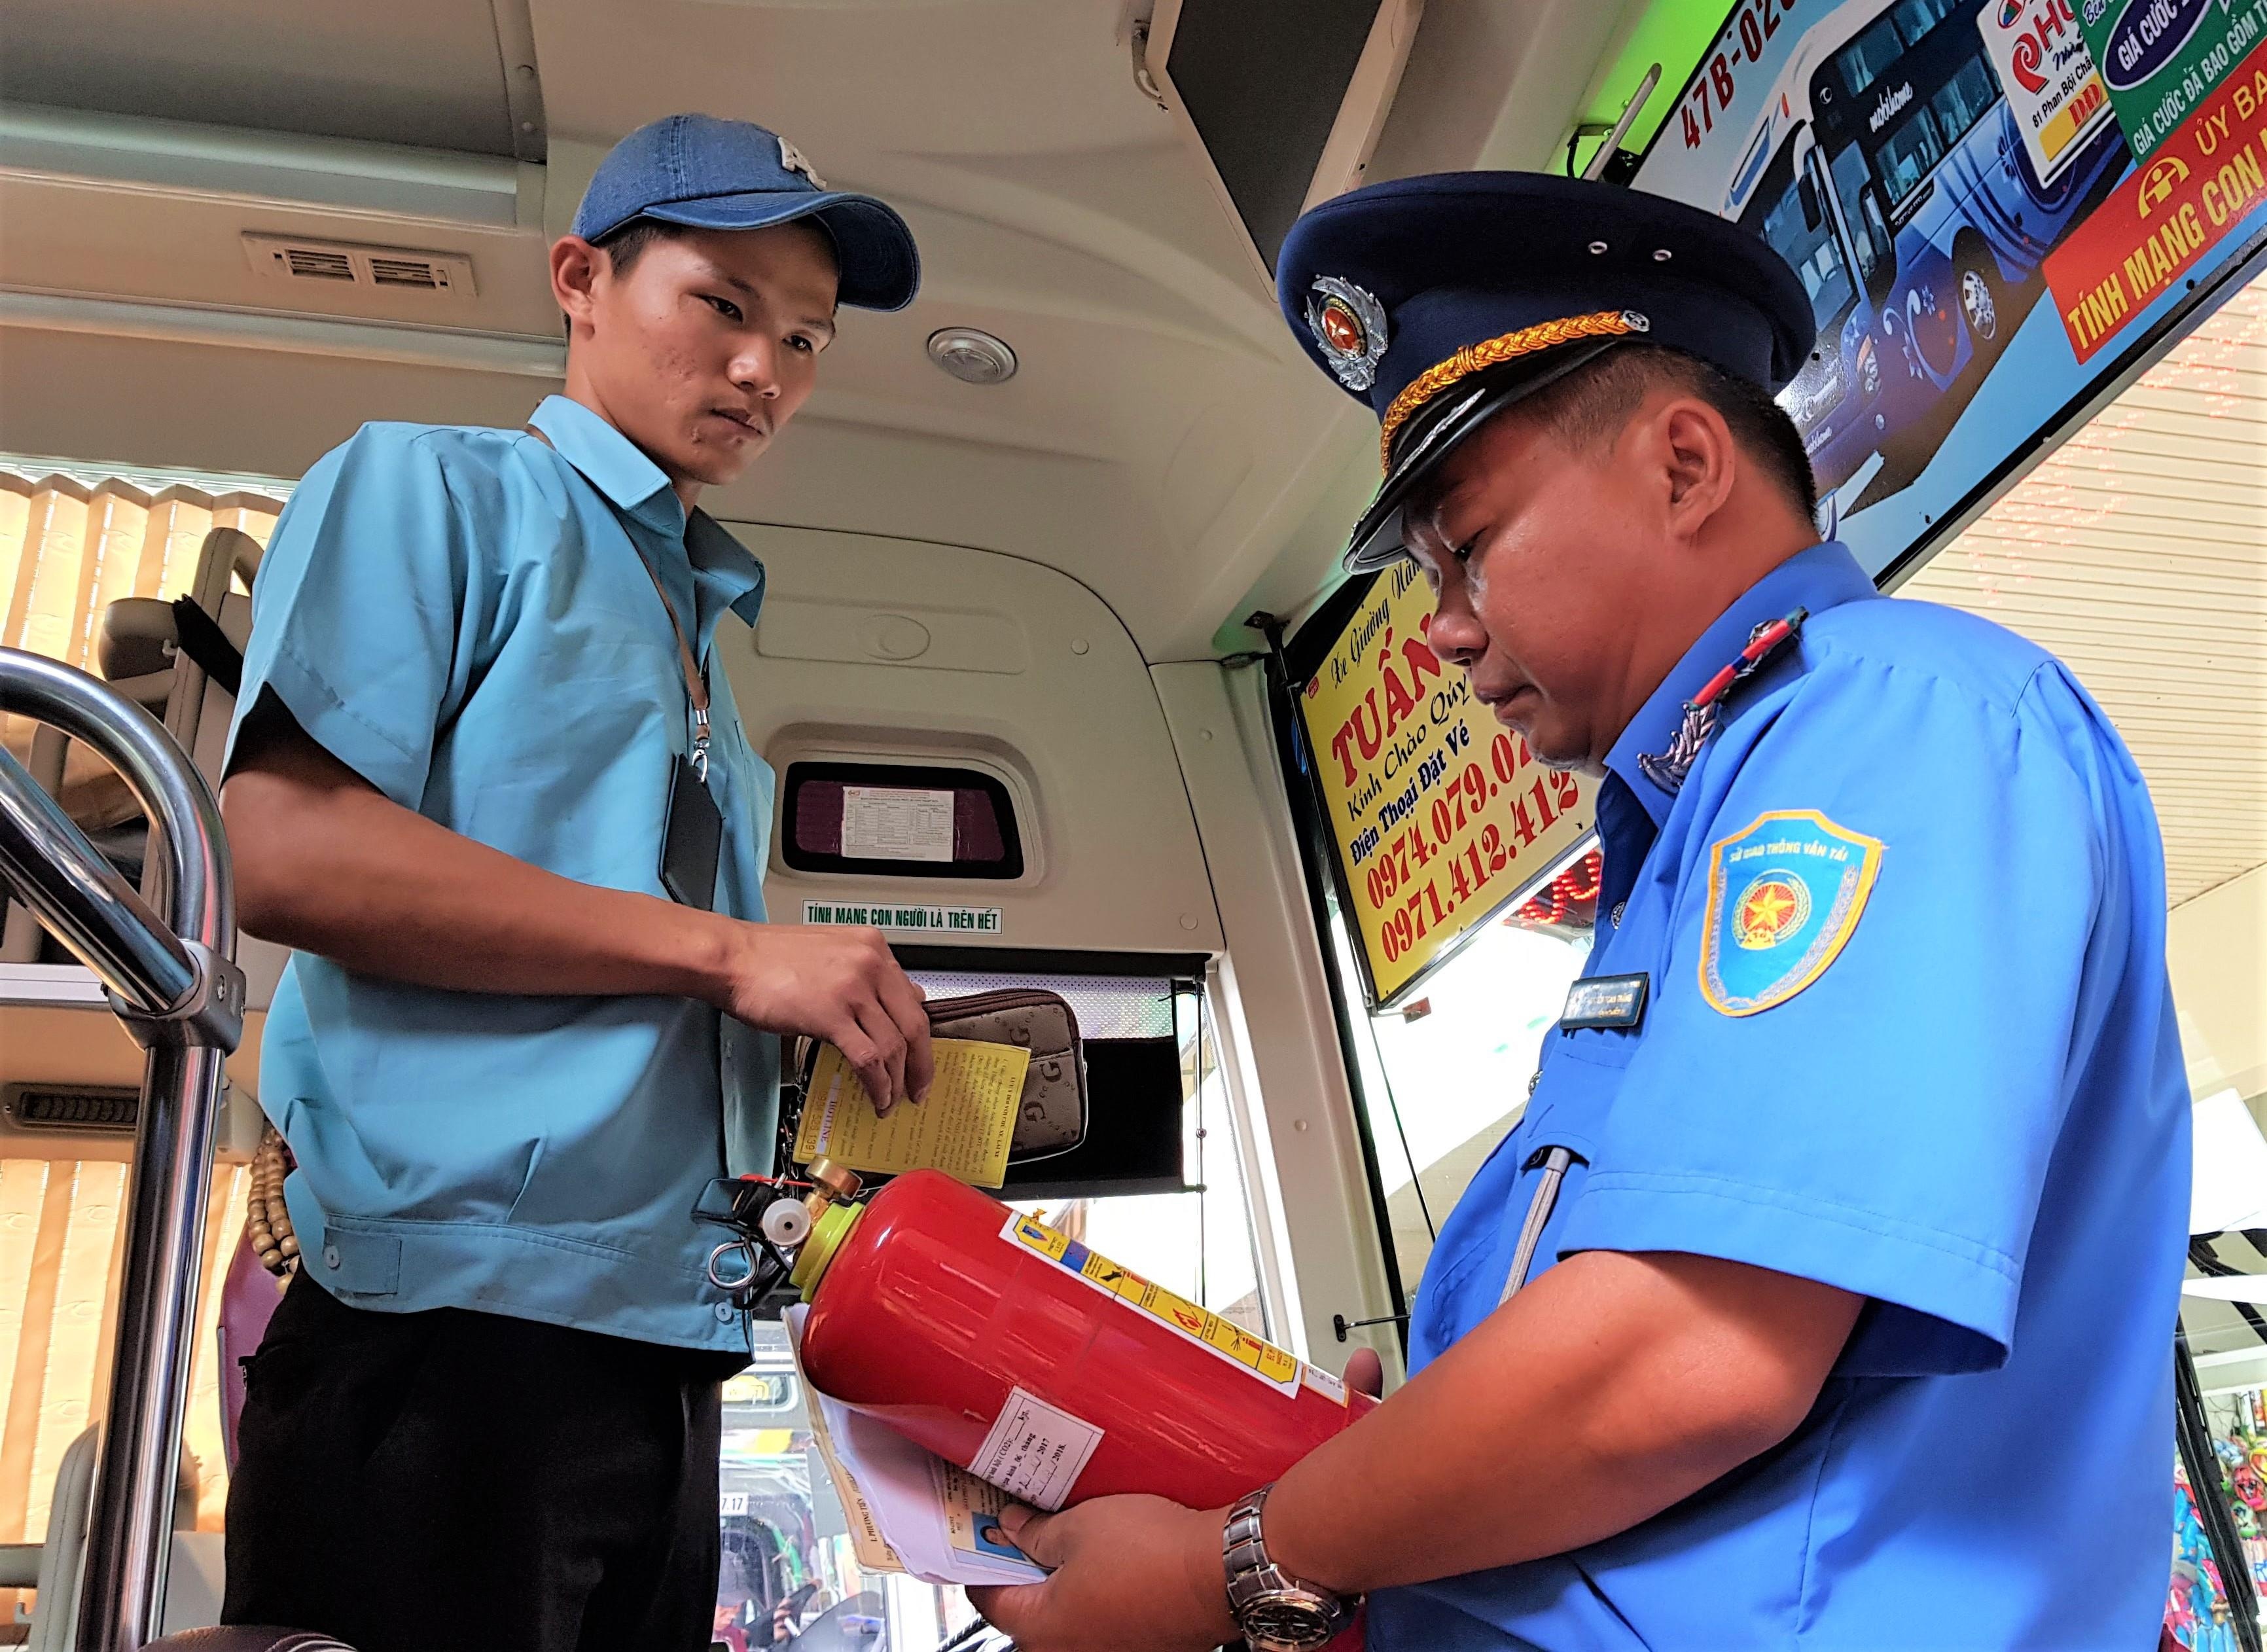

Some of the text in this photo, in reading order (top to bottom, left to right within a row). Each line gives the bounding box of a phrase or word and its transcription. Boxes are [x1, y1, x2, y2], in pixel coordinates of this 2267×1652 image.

[1681, 0, 1796, 151] 47B-02
[2032, 56, 2094, 128] 81 Phan Bội Châ
[2118, 26, 2144, 71] GIÁ
[2133, 117, 2156, 155] GIÁ
[2152, 89, 2186, 134] CƯỚC
[2200, 43, 2229, 83] BAO
[2226, 10, 2258, 55] GỒM
[2195, 105, 2230, 156] ỦY
[2067, 143, 2265, 350] TÍNH MẠNG CON
[1330, 651, 1349, 689] Xe
[1350, 597, 1390, 667] Giường
[1332, 613, 1441, 789] TUẤN
[1348, 772, 1382, 822] Kính
[1384, 724, 1426, 780] Chào
[1349, 718, 1470, 867] Điện Thoại Đặt Vé
[808, 903, 832, 924] TÍNH
[871, 908, 892, 925] CON
[895, 907, 927, 927] NGƯỜI
[931, 908, 944, 928] LÀ
[948, 909, 975, 929] TRÊN
[978, 908, 997, 930] HẾT
[820, 1100, 838, 1143] HOTLINE
[1036, 1437, 1050, 1455] 2017
